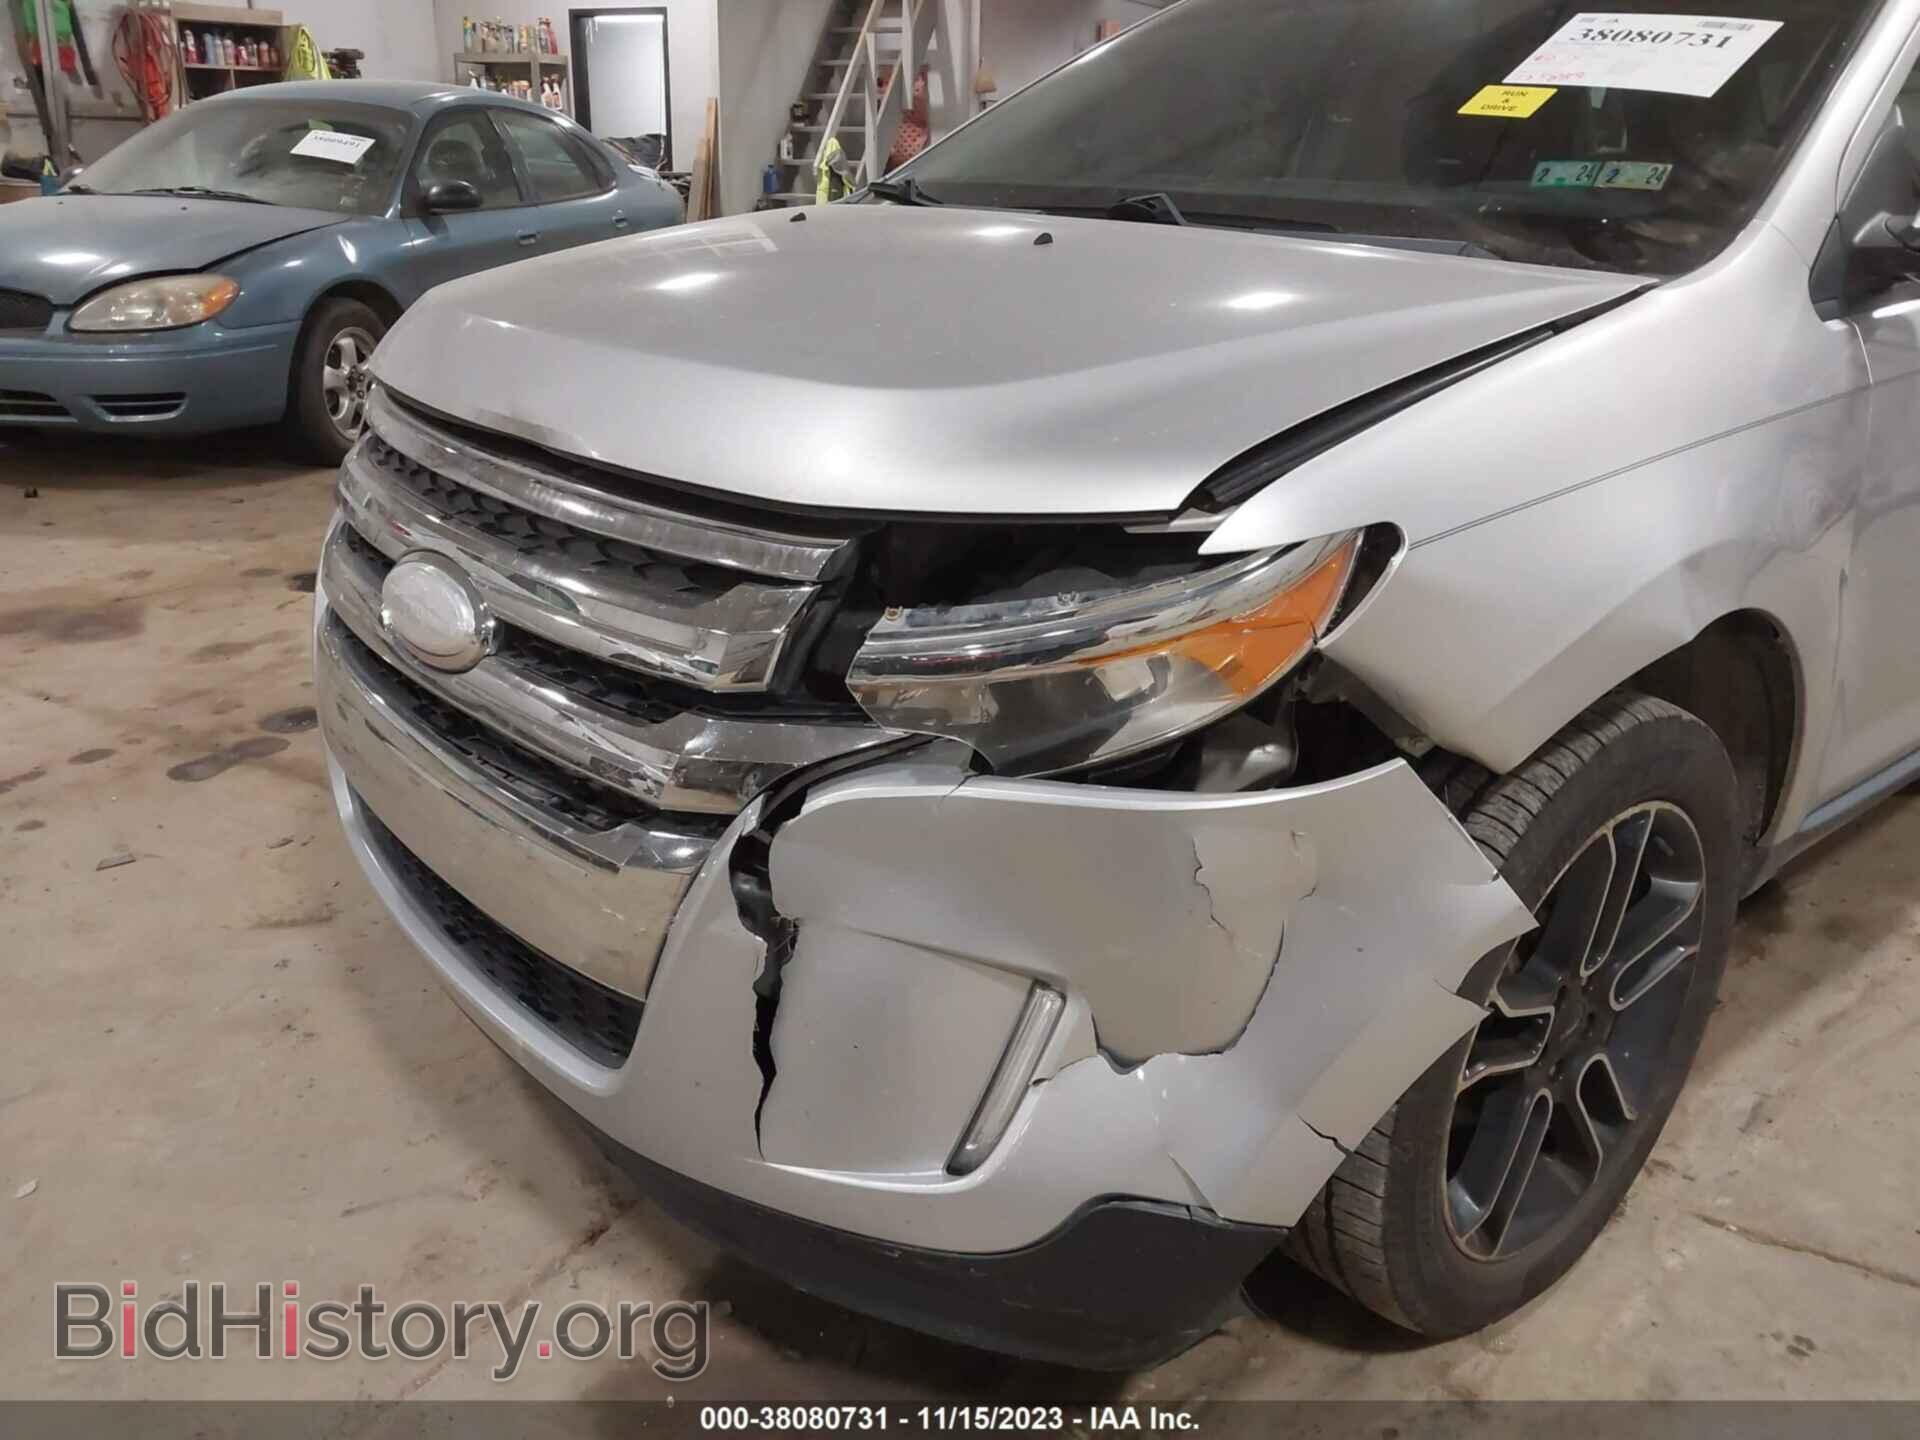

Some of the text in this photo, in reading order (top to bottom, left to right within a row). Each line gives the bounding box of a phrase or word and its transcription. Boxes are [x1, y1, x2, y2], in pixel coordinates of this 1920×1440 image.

[1568, 27, 1735, 50] 38080731
[1501, 89, 1529, 97] RUN
[1480, 103, 1518, 112] DRIVE
